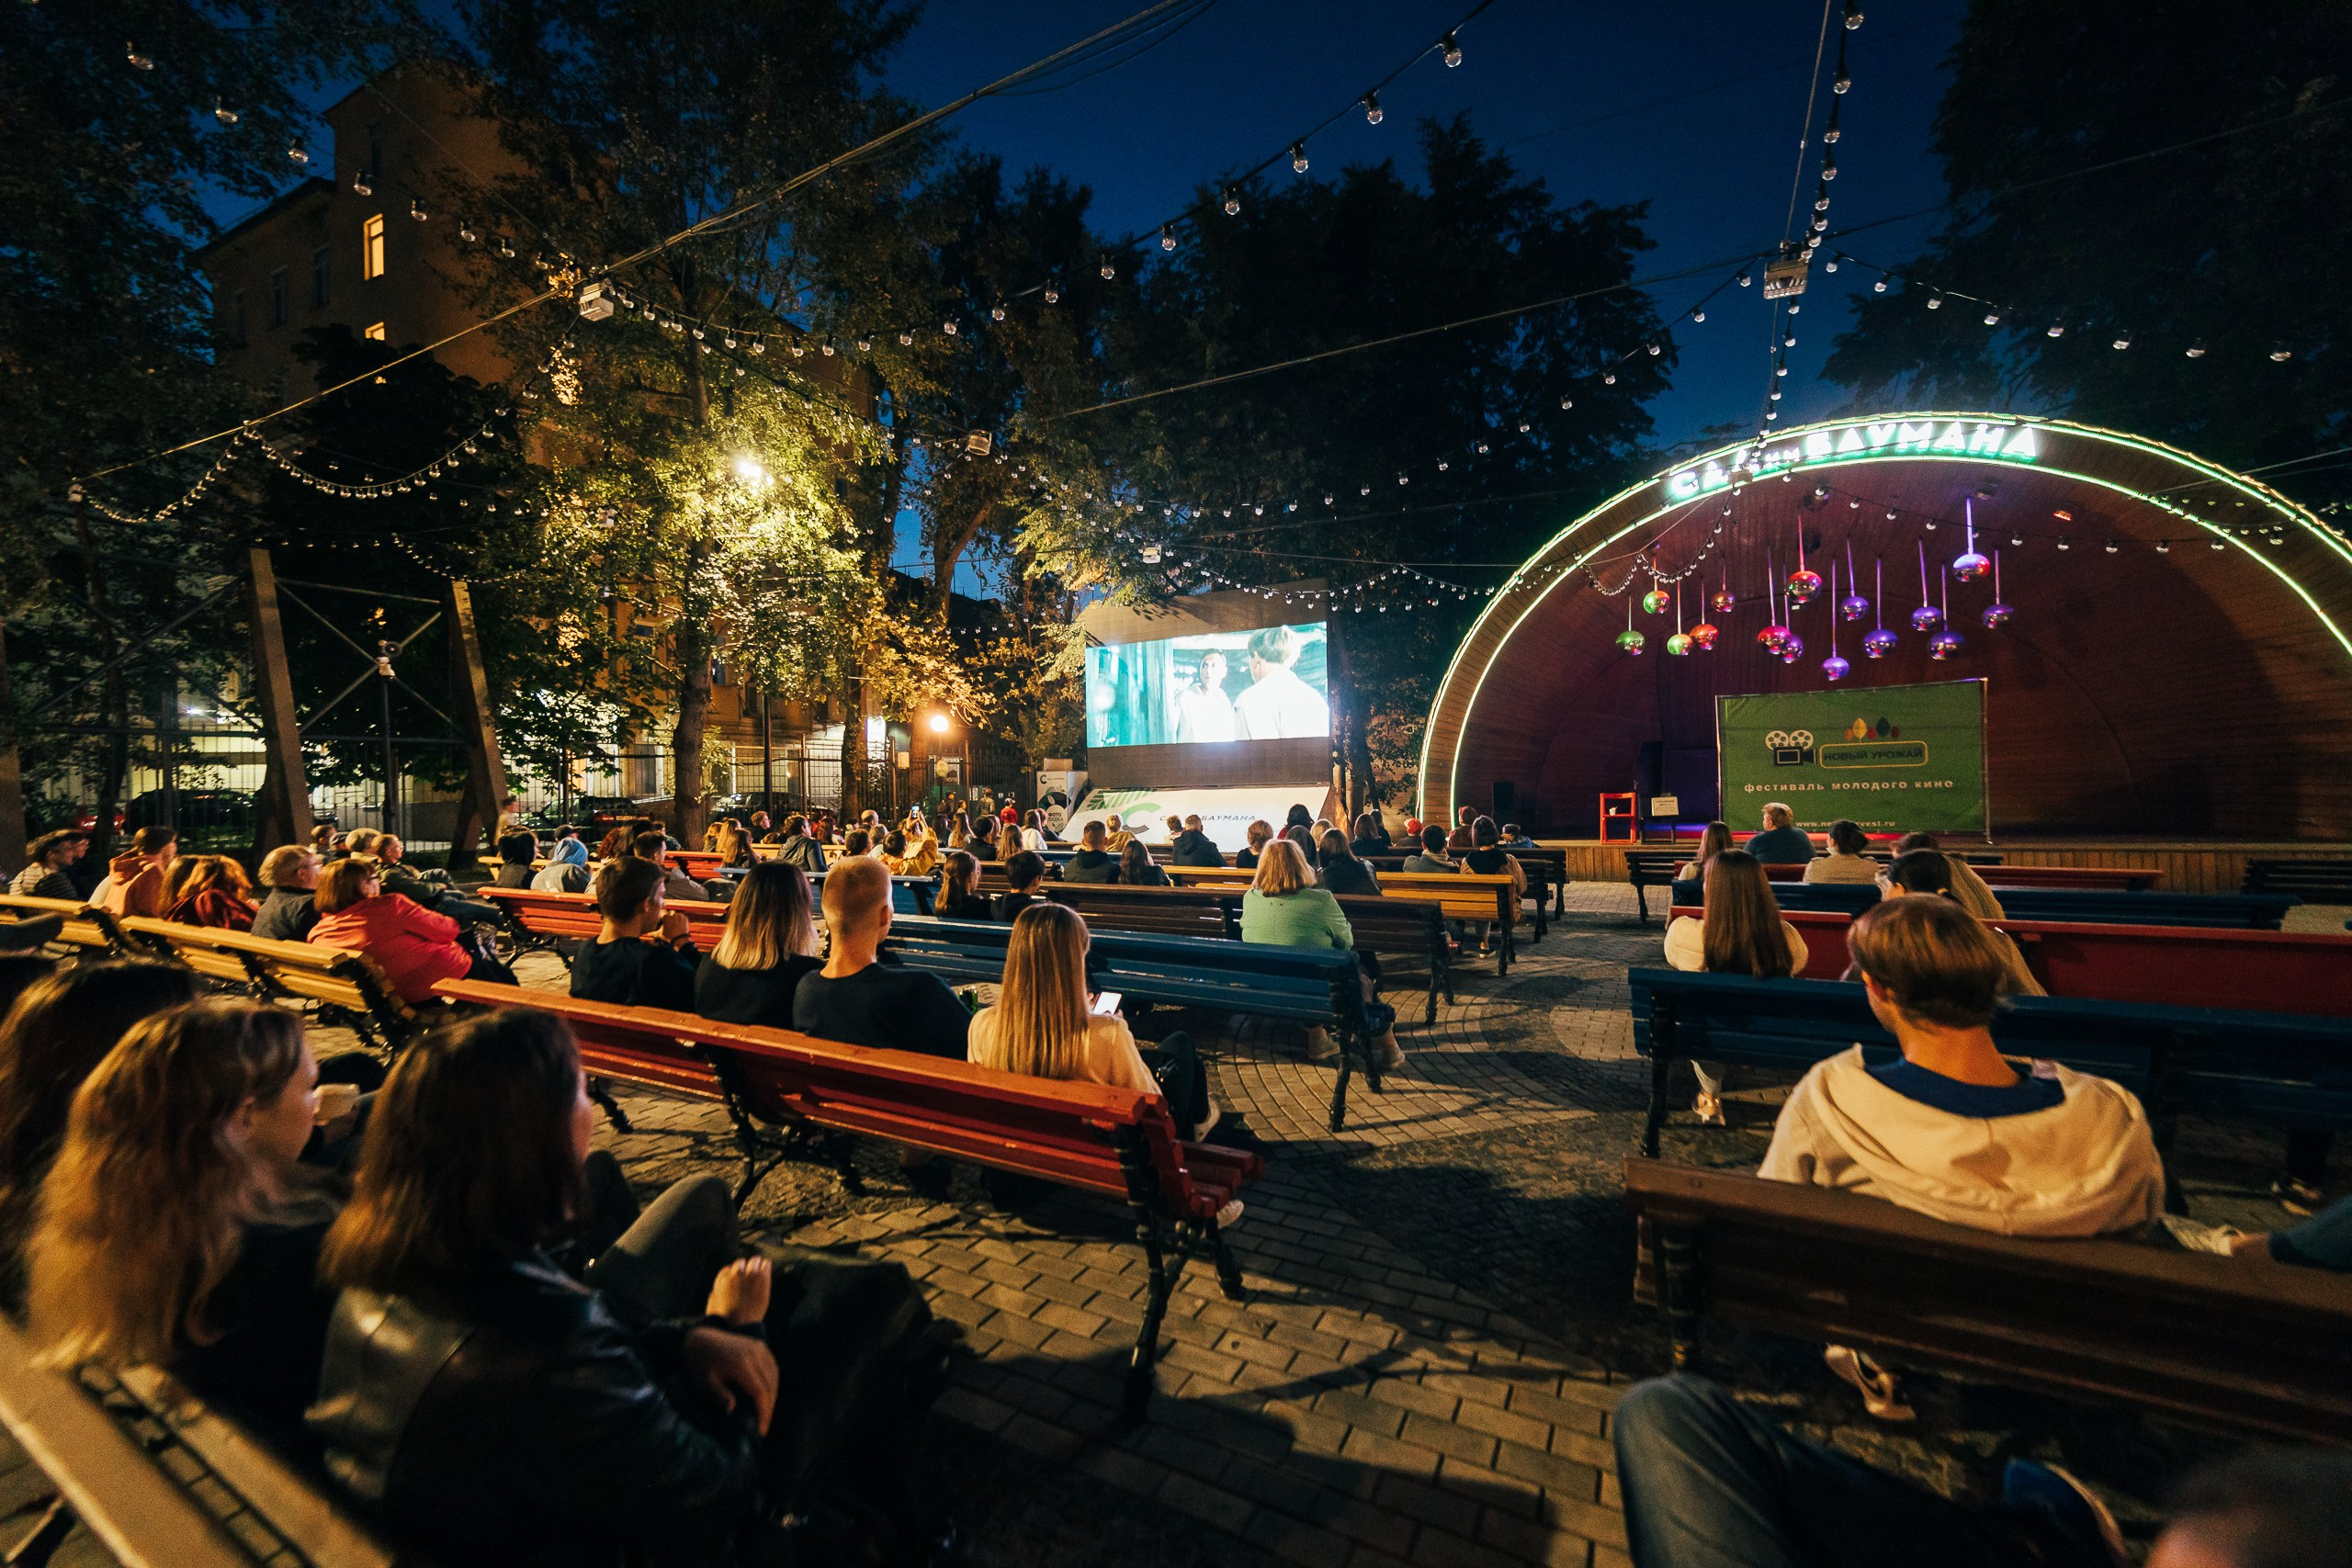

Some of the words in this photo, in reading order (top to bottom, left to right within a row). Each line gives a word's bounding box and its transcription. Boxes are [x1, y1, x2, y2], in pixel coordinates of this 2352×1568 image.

[1805, 421, 2037, 458] БАУМАНА
[1824, 750, 1868, 761] НОВЫЙ
[1871, 746, 1923, 760] УРОЖАЙ
[1744, 783, 1825, 794] фестиваль
[1831, 781, 1907, 792] молодого
[1915, 780, 1954, 789] кино
